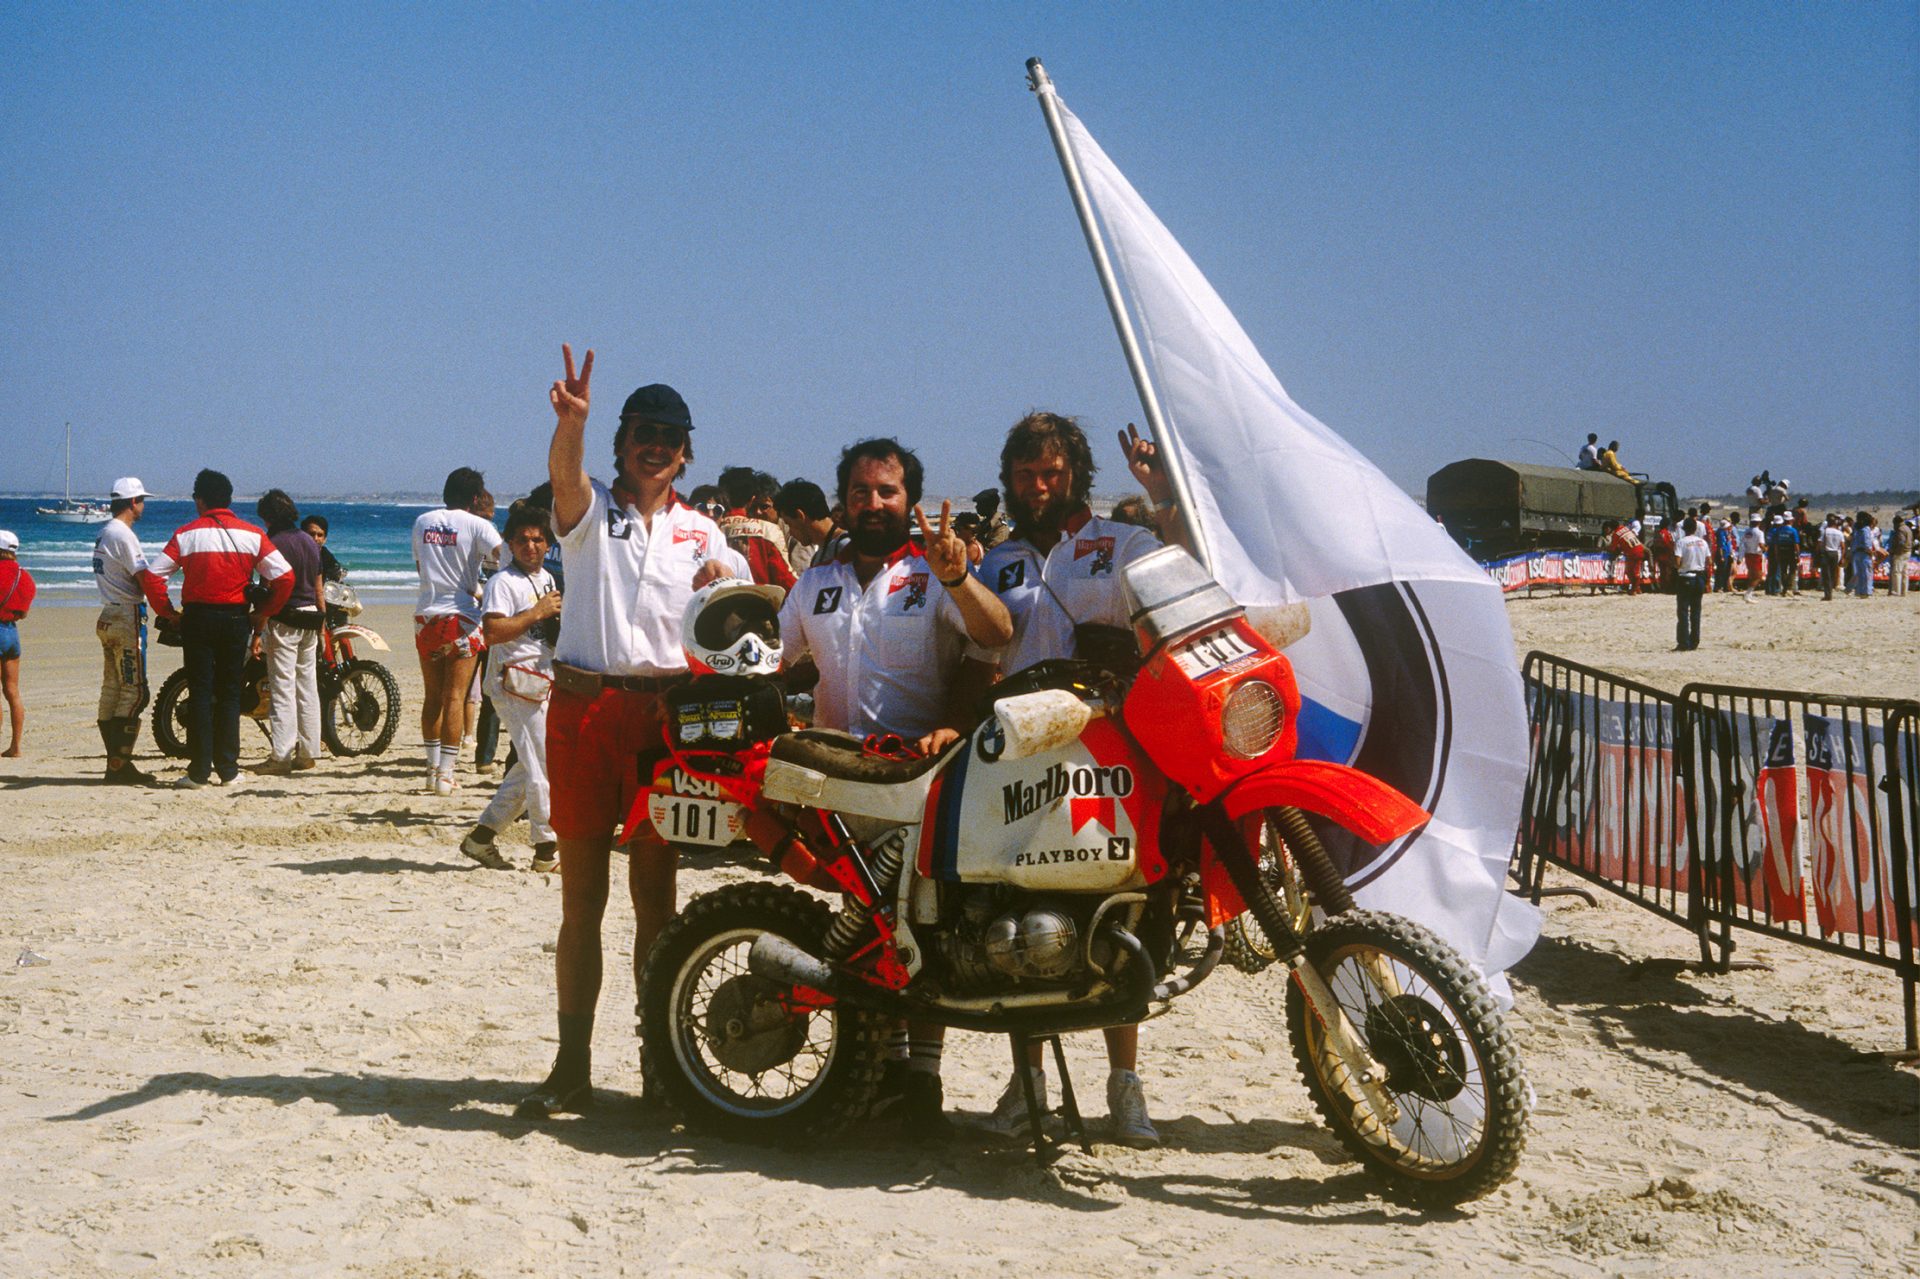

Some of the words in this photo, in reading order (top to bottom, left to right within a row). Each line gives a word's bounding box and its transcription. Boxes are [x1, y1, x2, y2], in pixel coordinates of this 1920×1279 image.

[708, 654, 731, 665] Arai
[1003, 762, 1133, 825] Marlboro
[671, 802, 717, 840] 101
[1015, 848, 1103, 867] PLAYBOY
